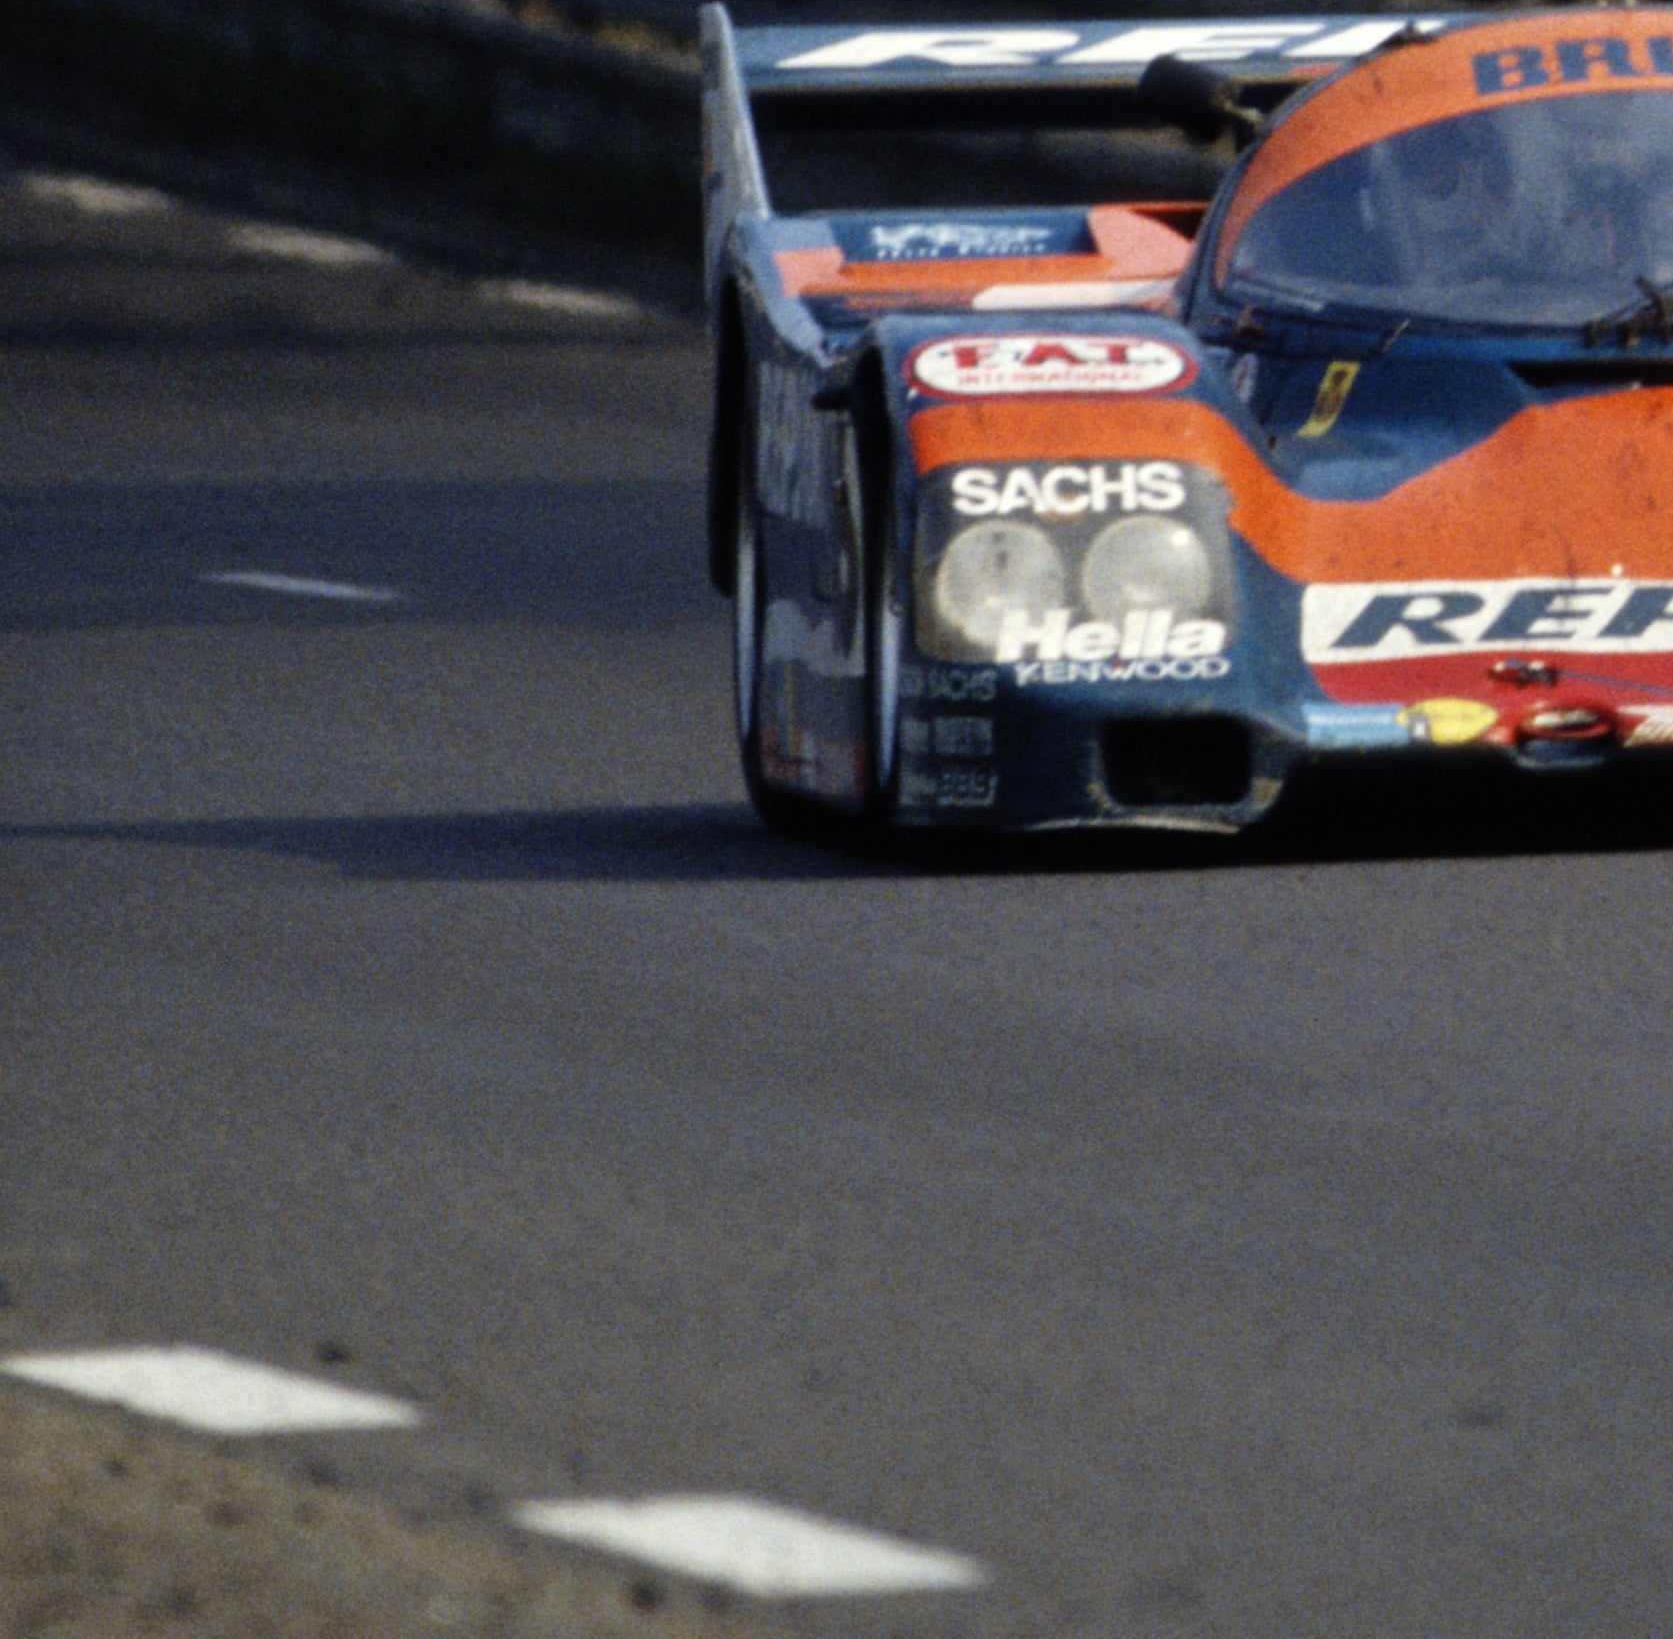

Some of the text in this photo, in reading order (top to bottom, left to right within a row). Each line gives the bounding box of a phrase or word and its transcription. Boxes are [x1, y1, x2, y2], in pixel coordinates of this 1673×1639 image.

[951, 462, 1184, 515] SACHS
[997, 608, 1226, 663] Hella
[1013, 659, 1231, 686] KENWOOD
